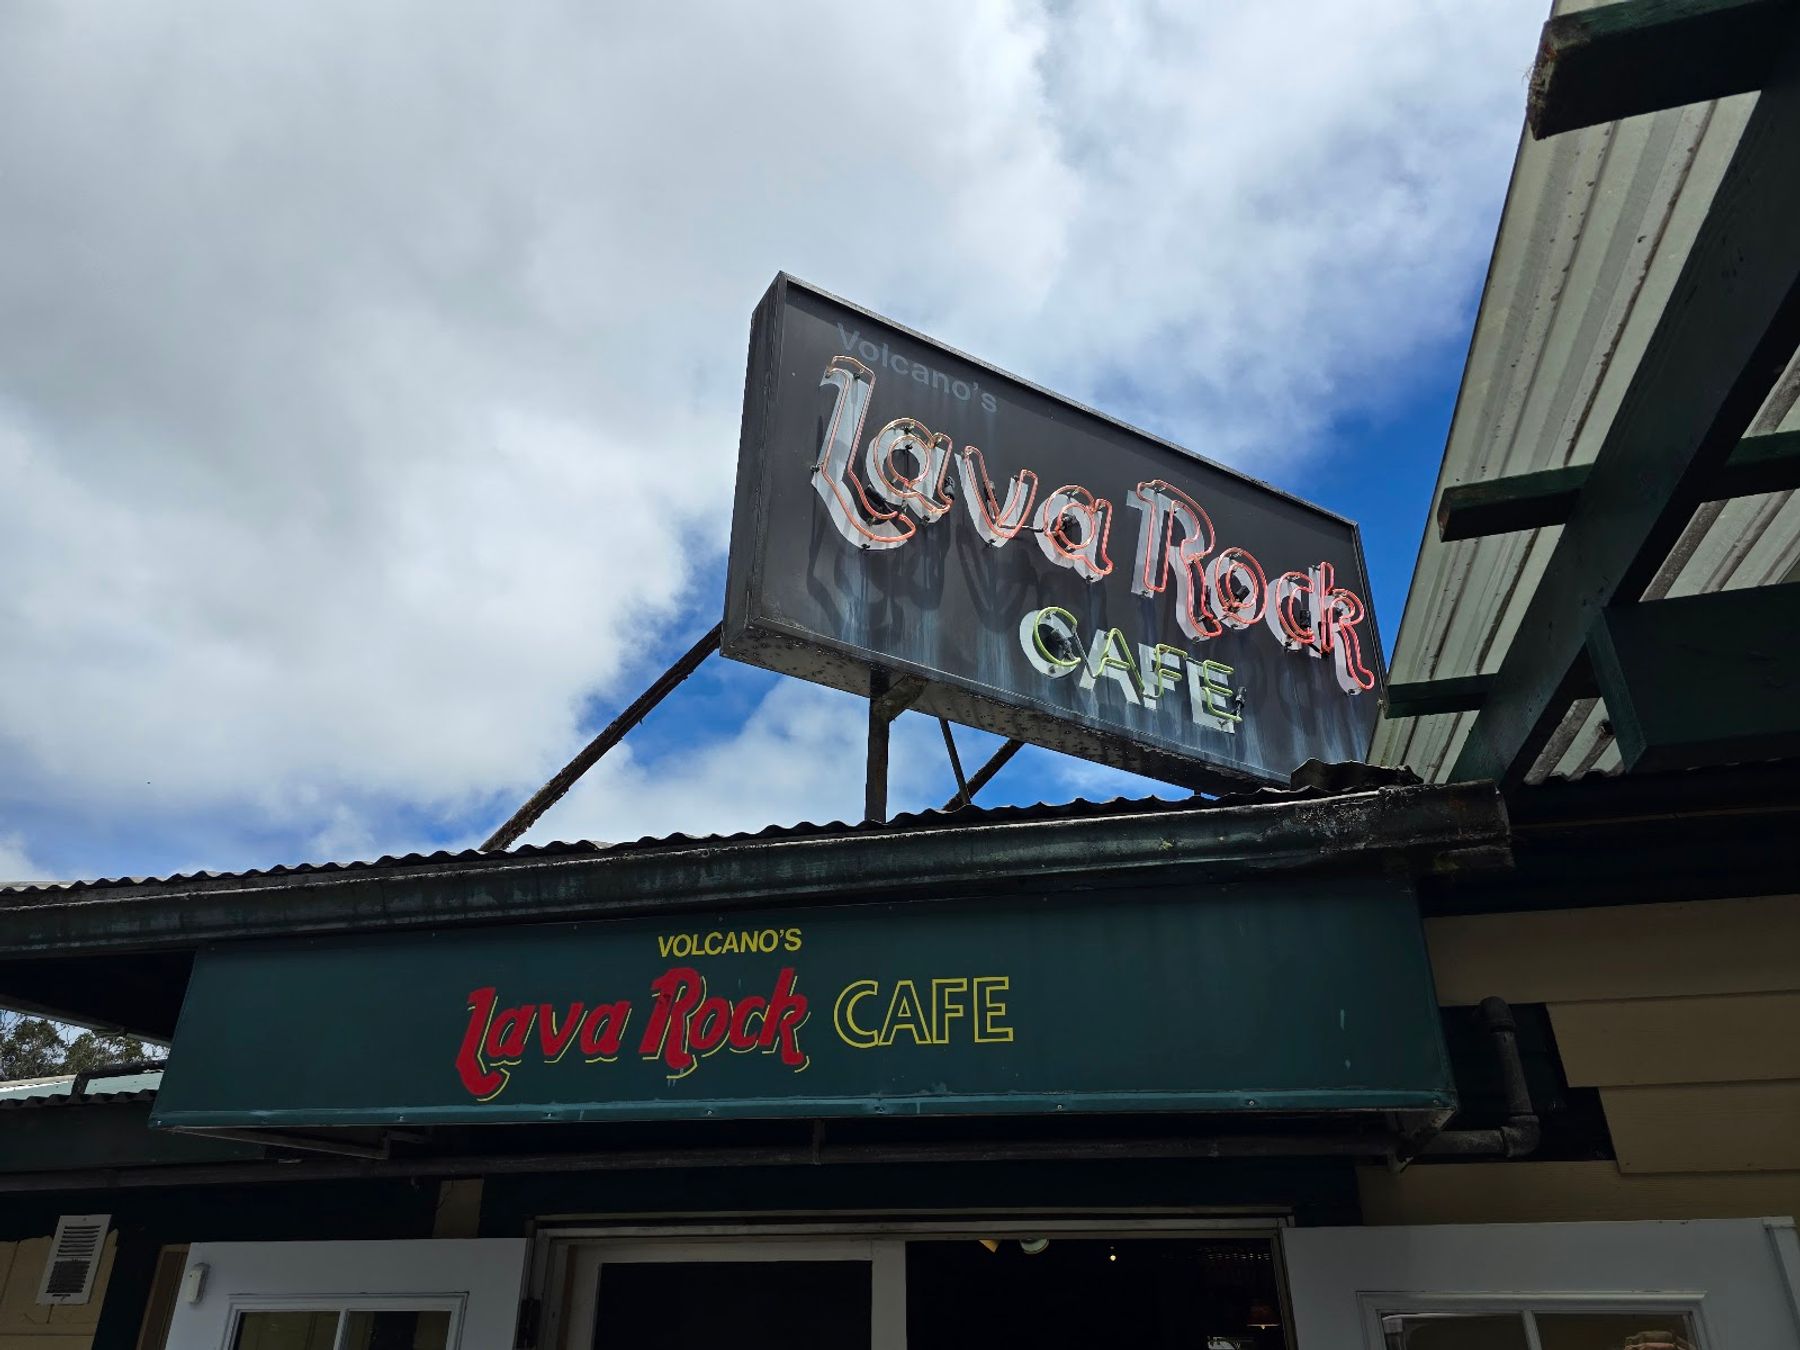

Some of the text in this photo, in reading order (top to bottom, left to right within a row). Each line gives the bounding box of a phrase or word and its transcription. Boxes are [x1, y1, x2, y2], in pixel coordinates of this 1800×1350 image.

[837, 321, 998, 413] Volcano's
[811, 356, 1375, 695] Lava Rock
[1019, 606, 1244, 734] CAFE
[657, 928, 803, 958] VOLCANO'S
[455, 966, 1014, 1101] Lava Rock CAFE
